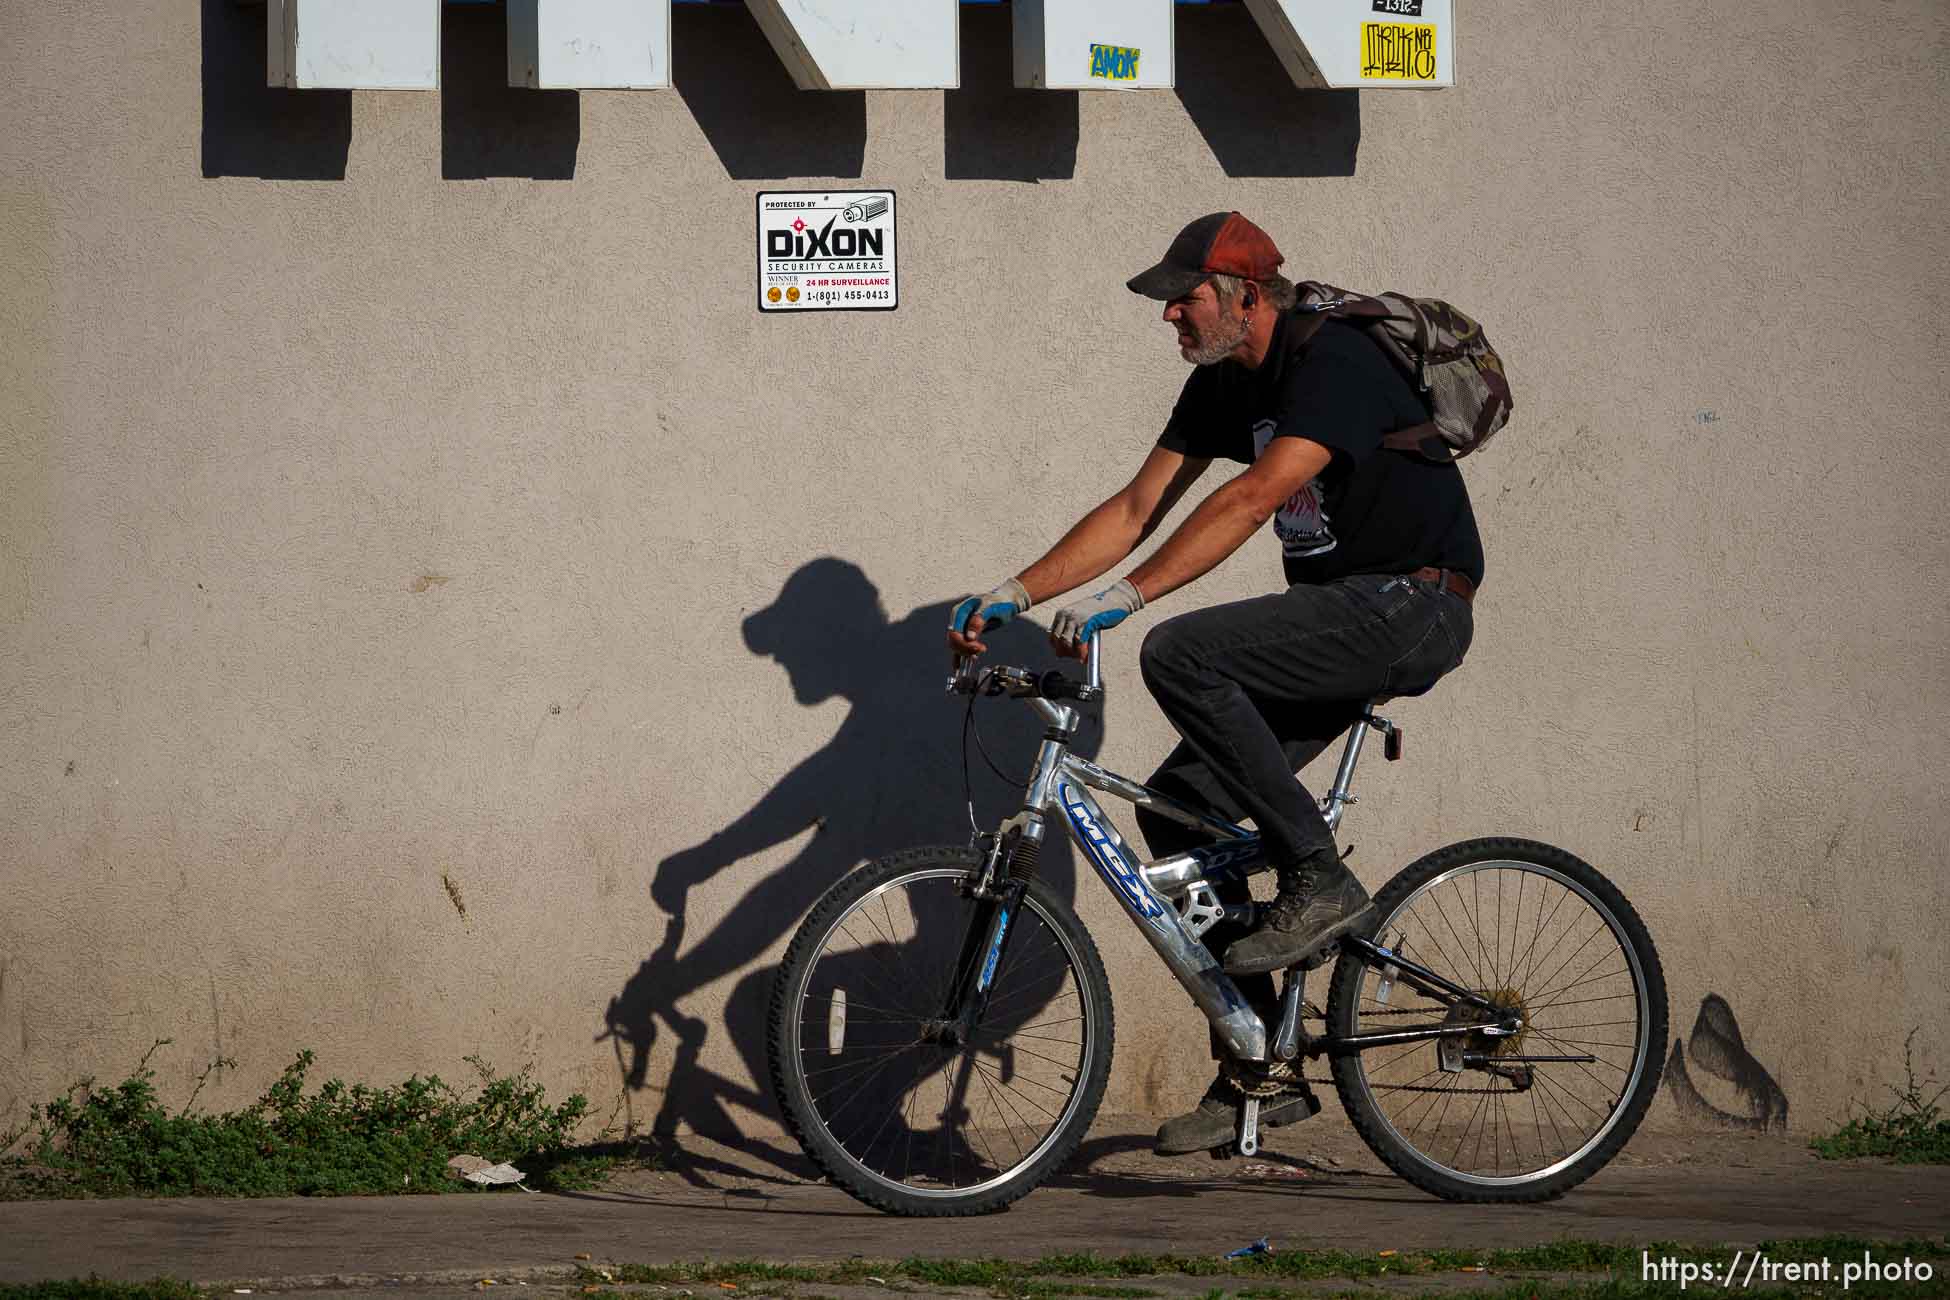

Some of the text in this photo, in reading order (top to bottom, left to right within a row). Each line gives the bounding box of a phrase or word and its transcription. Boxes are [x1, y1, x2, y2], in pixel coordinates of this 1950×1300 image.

[768, 261, 883, 271] SECURITY CAMERAS
[806, 279, 817, 287] 24
[831, 278, 890, 286] SURVEILLANCE
[807, 290, 889, 301] 1-(801) 455-0413
